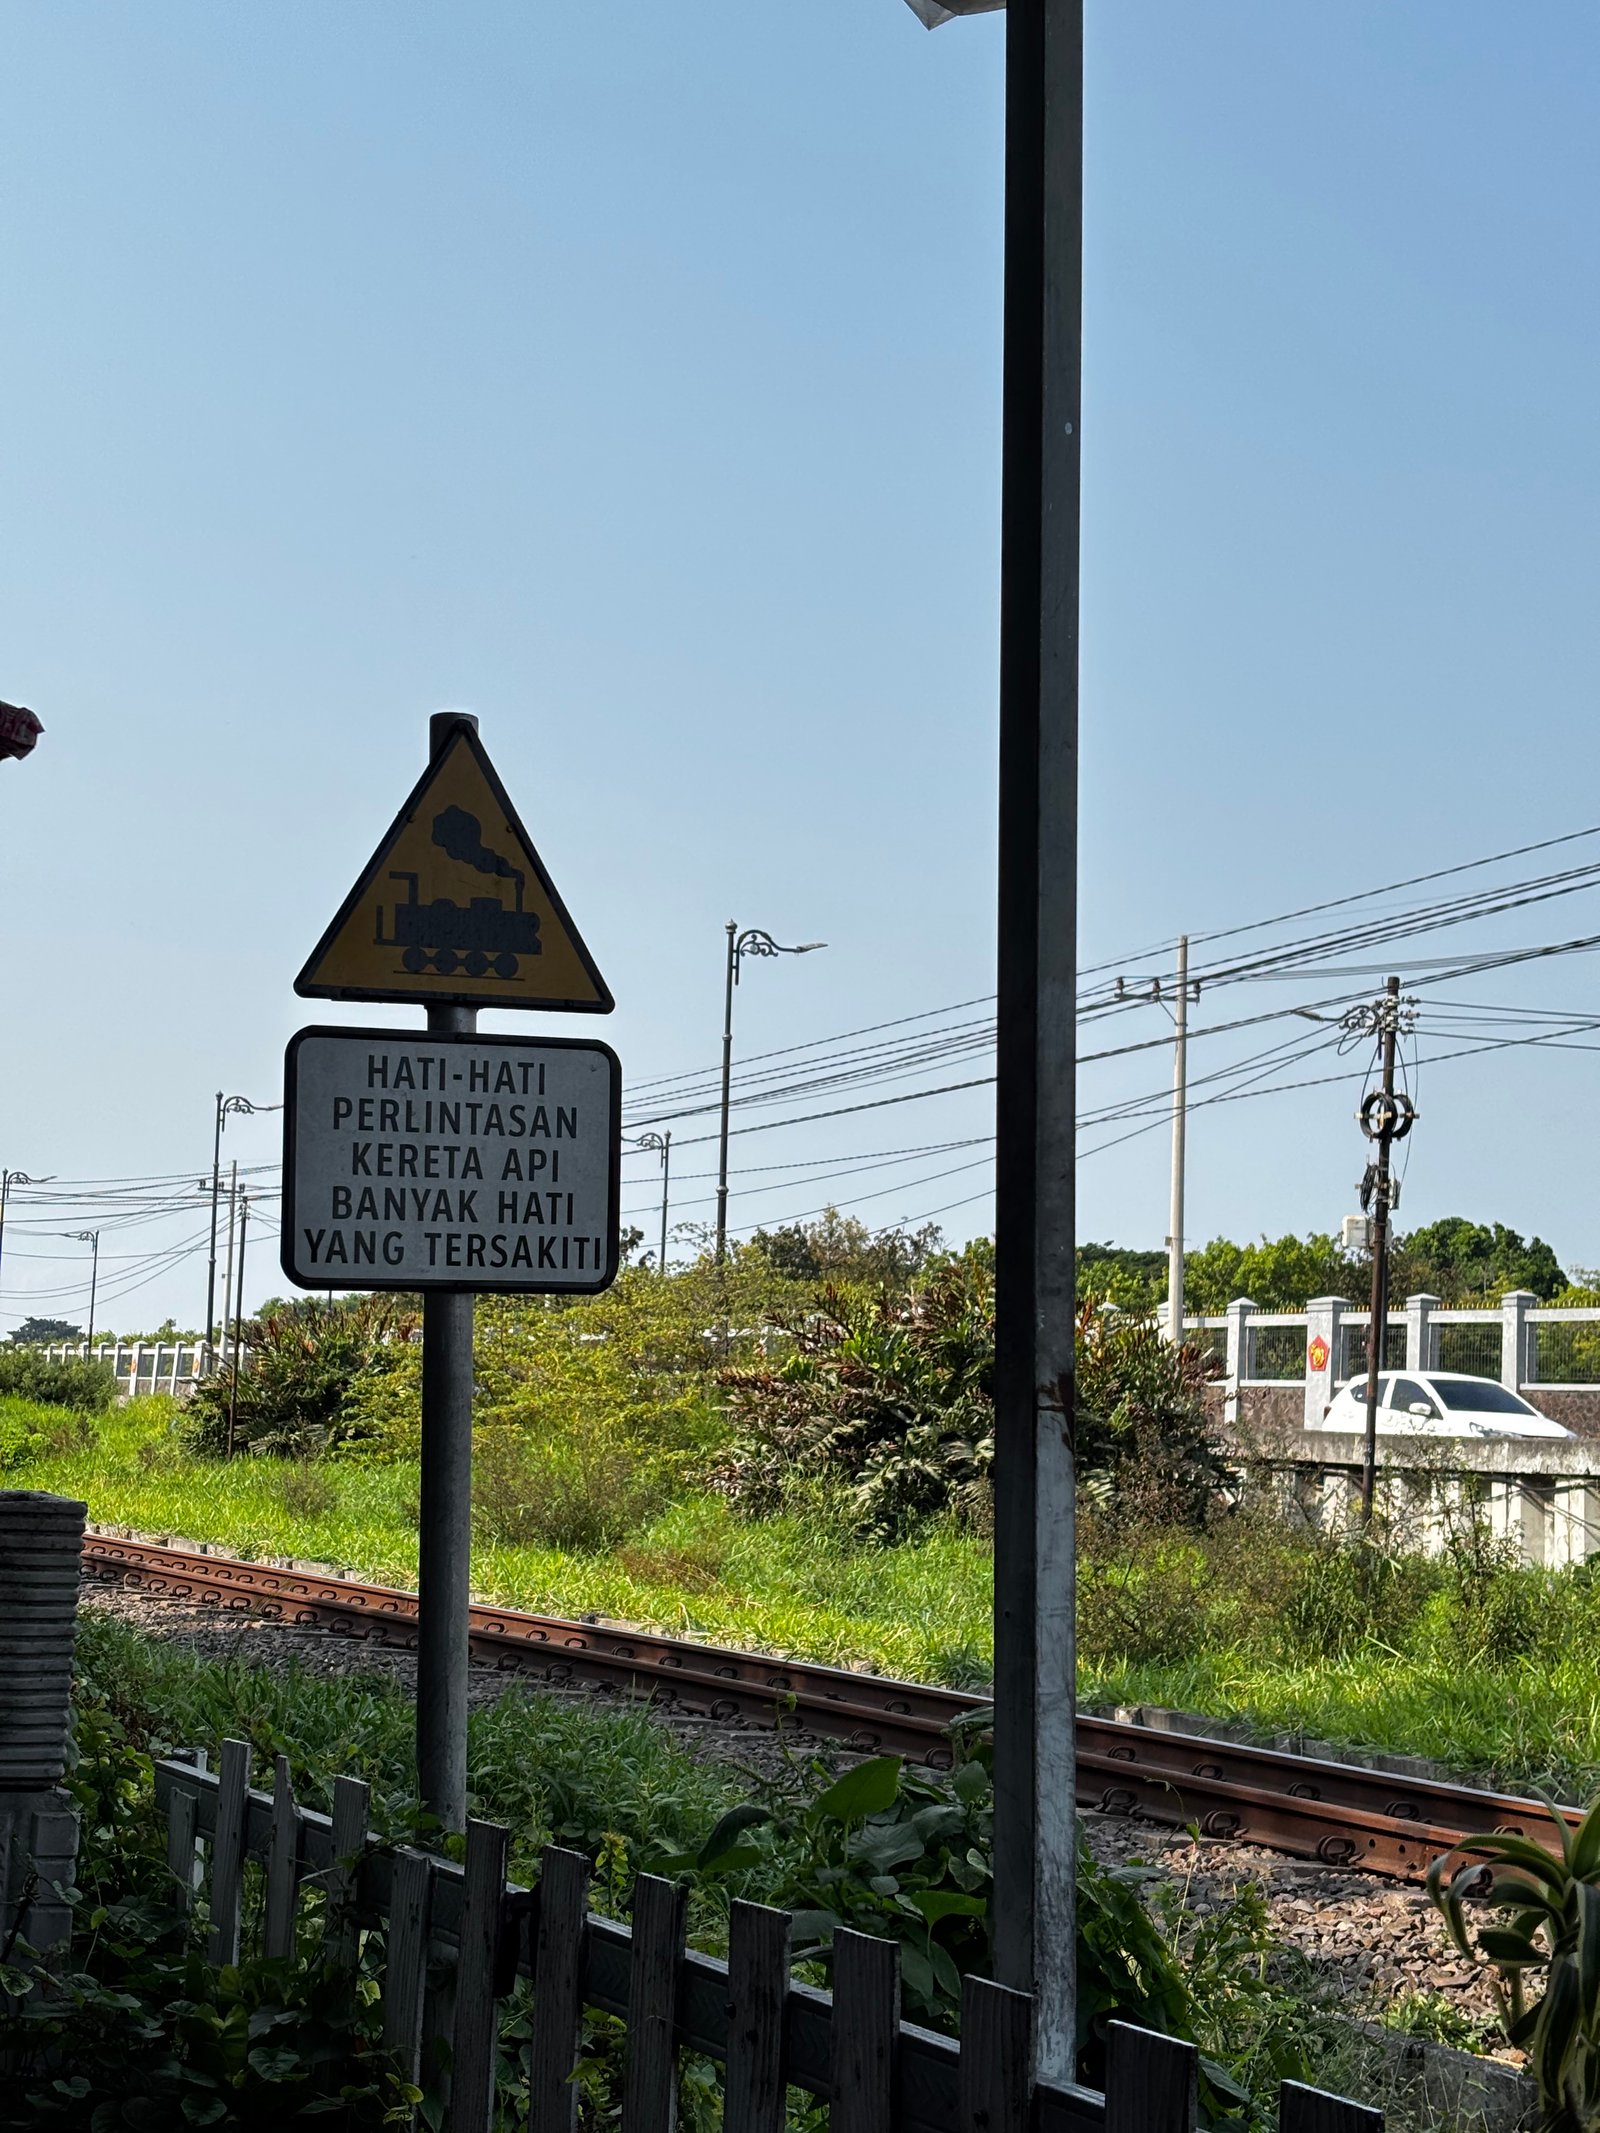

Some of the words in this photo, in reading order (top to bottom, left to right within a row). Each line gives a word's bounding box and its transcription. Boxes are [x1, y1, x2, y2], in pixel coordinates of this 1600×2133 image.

[367, 1054, 545, 1096] HATI-HATI
[333, 1096, 578, 1139] PERLINTASAN
[351, 1141, 484, 1180] KERETA
[501, 1147, 559, 1183] API
[332, 1185, 479, 1223] BANYAK
[498, 1190, 574, 1226] HATI
[303, 1228, 405, 1266] YANG
[423, 1232, 601, 1270] TERSAKITI
